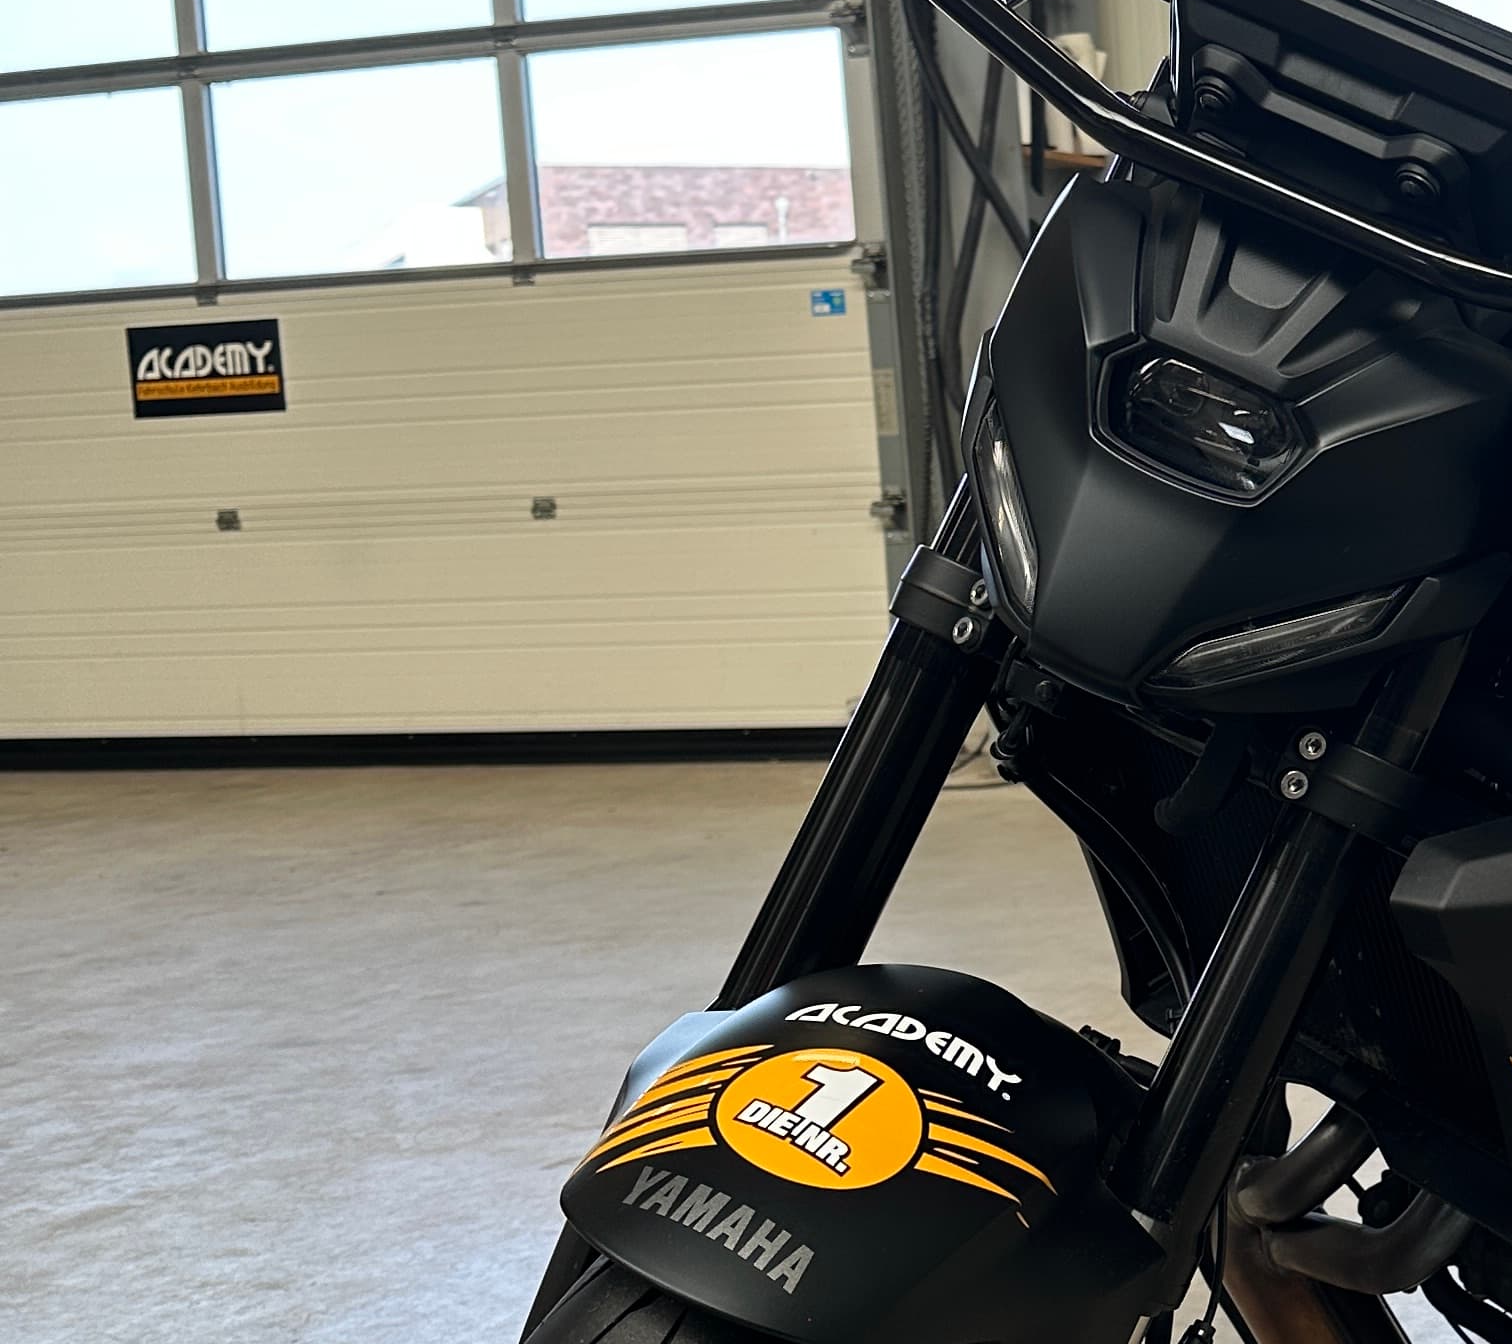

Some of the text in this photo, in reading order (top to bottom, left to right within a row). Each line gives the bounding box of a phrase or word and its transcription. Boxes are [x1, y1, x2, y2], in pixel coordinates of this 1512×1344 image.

[137, 341, 272, 380] ACADEMY
[784, 1002, 1023, 1094] ACADEMY
[735, 1098, 804, 1138] DIE
[792, 1064, 882, 1135] 1
[621, 1165, 816, 1296] YAMAHA
